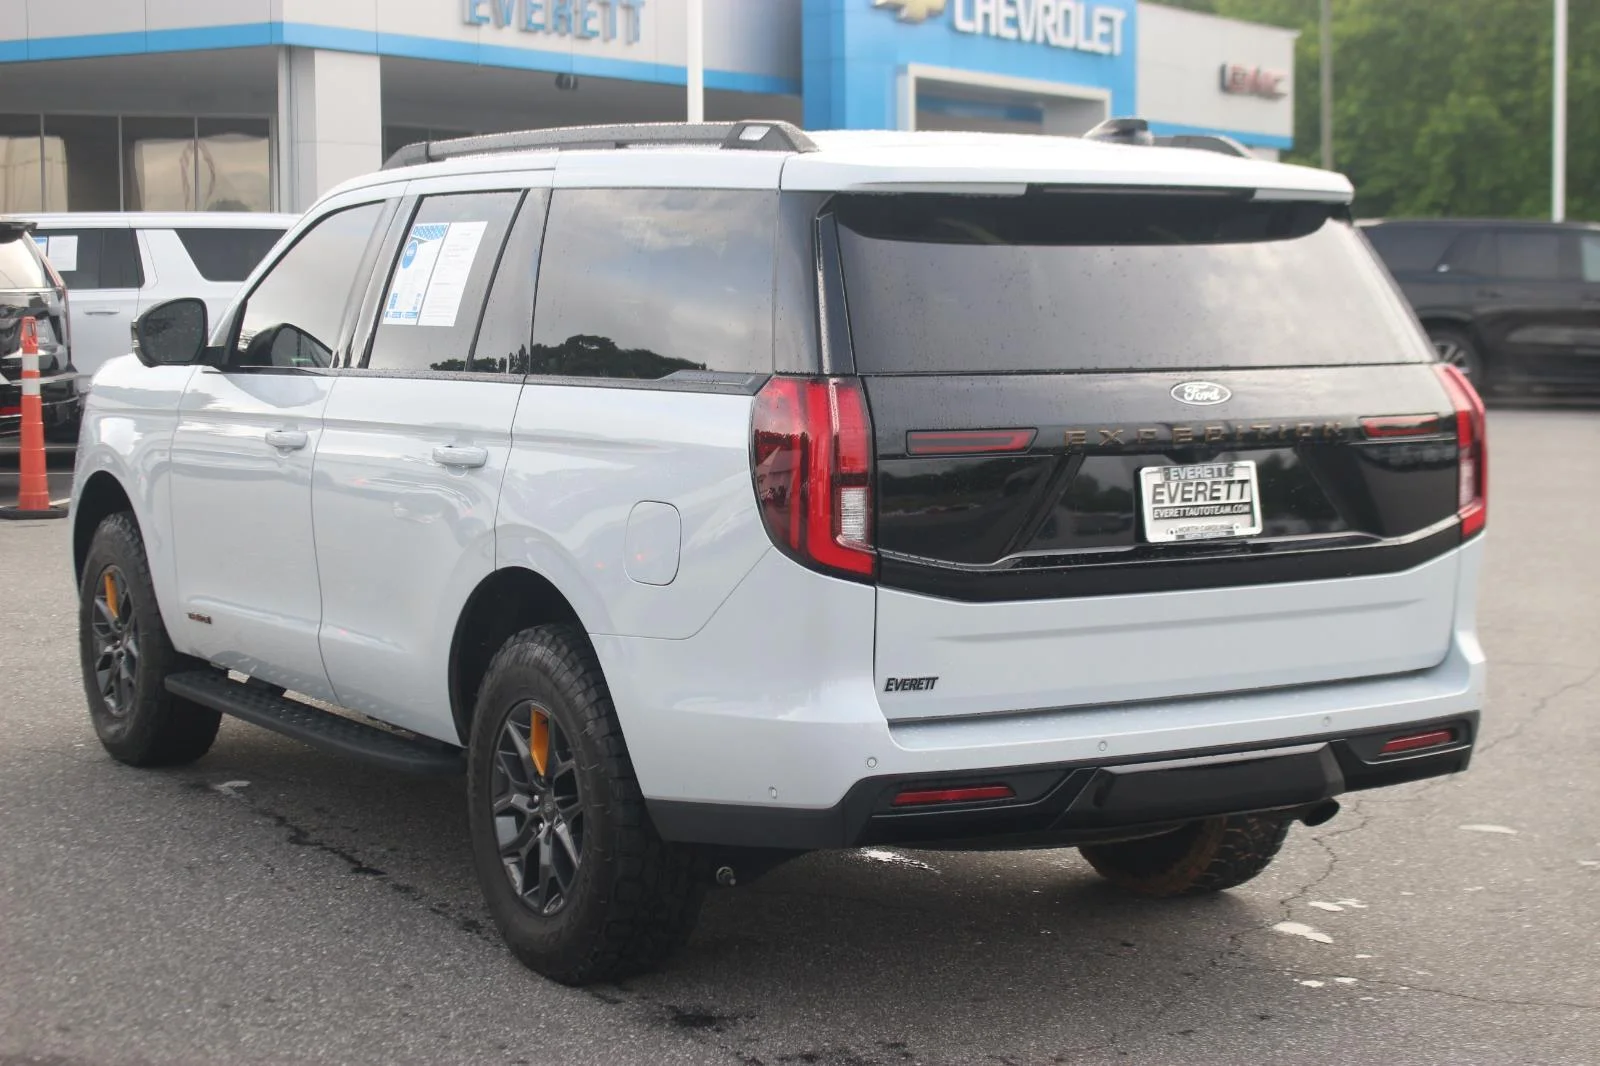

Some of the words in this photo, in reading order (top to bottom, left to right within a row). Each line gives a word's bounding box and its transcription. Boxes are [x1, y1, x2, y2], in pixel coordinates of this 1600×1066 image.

[954, 0, 1126, 56] CHEVROLET
[1183, 384, 1220, 401] Ford
[1064, 421, 1343, 447] EXPEDITION
[1169, 465, 1230, 481] EVERETT
[1151, 479, 1249, 505] EVERETT
[1153, 504, 1251, 519] EVERETTAUTOTEAM.COM
[884, 676, 939, 692] EVERETT
